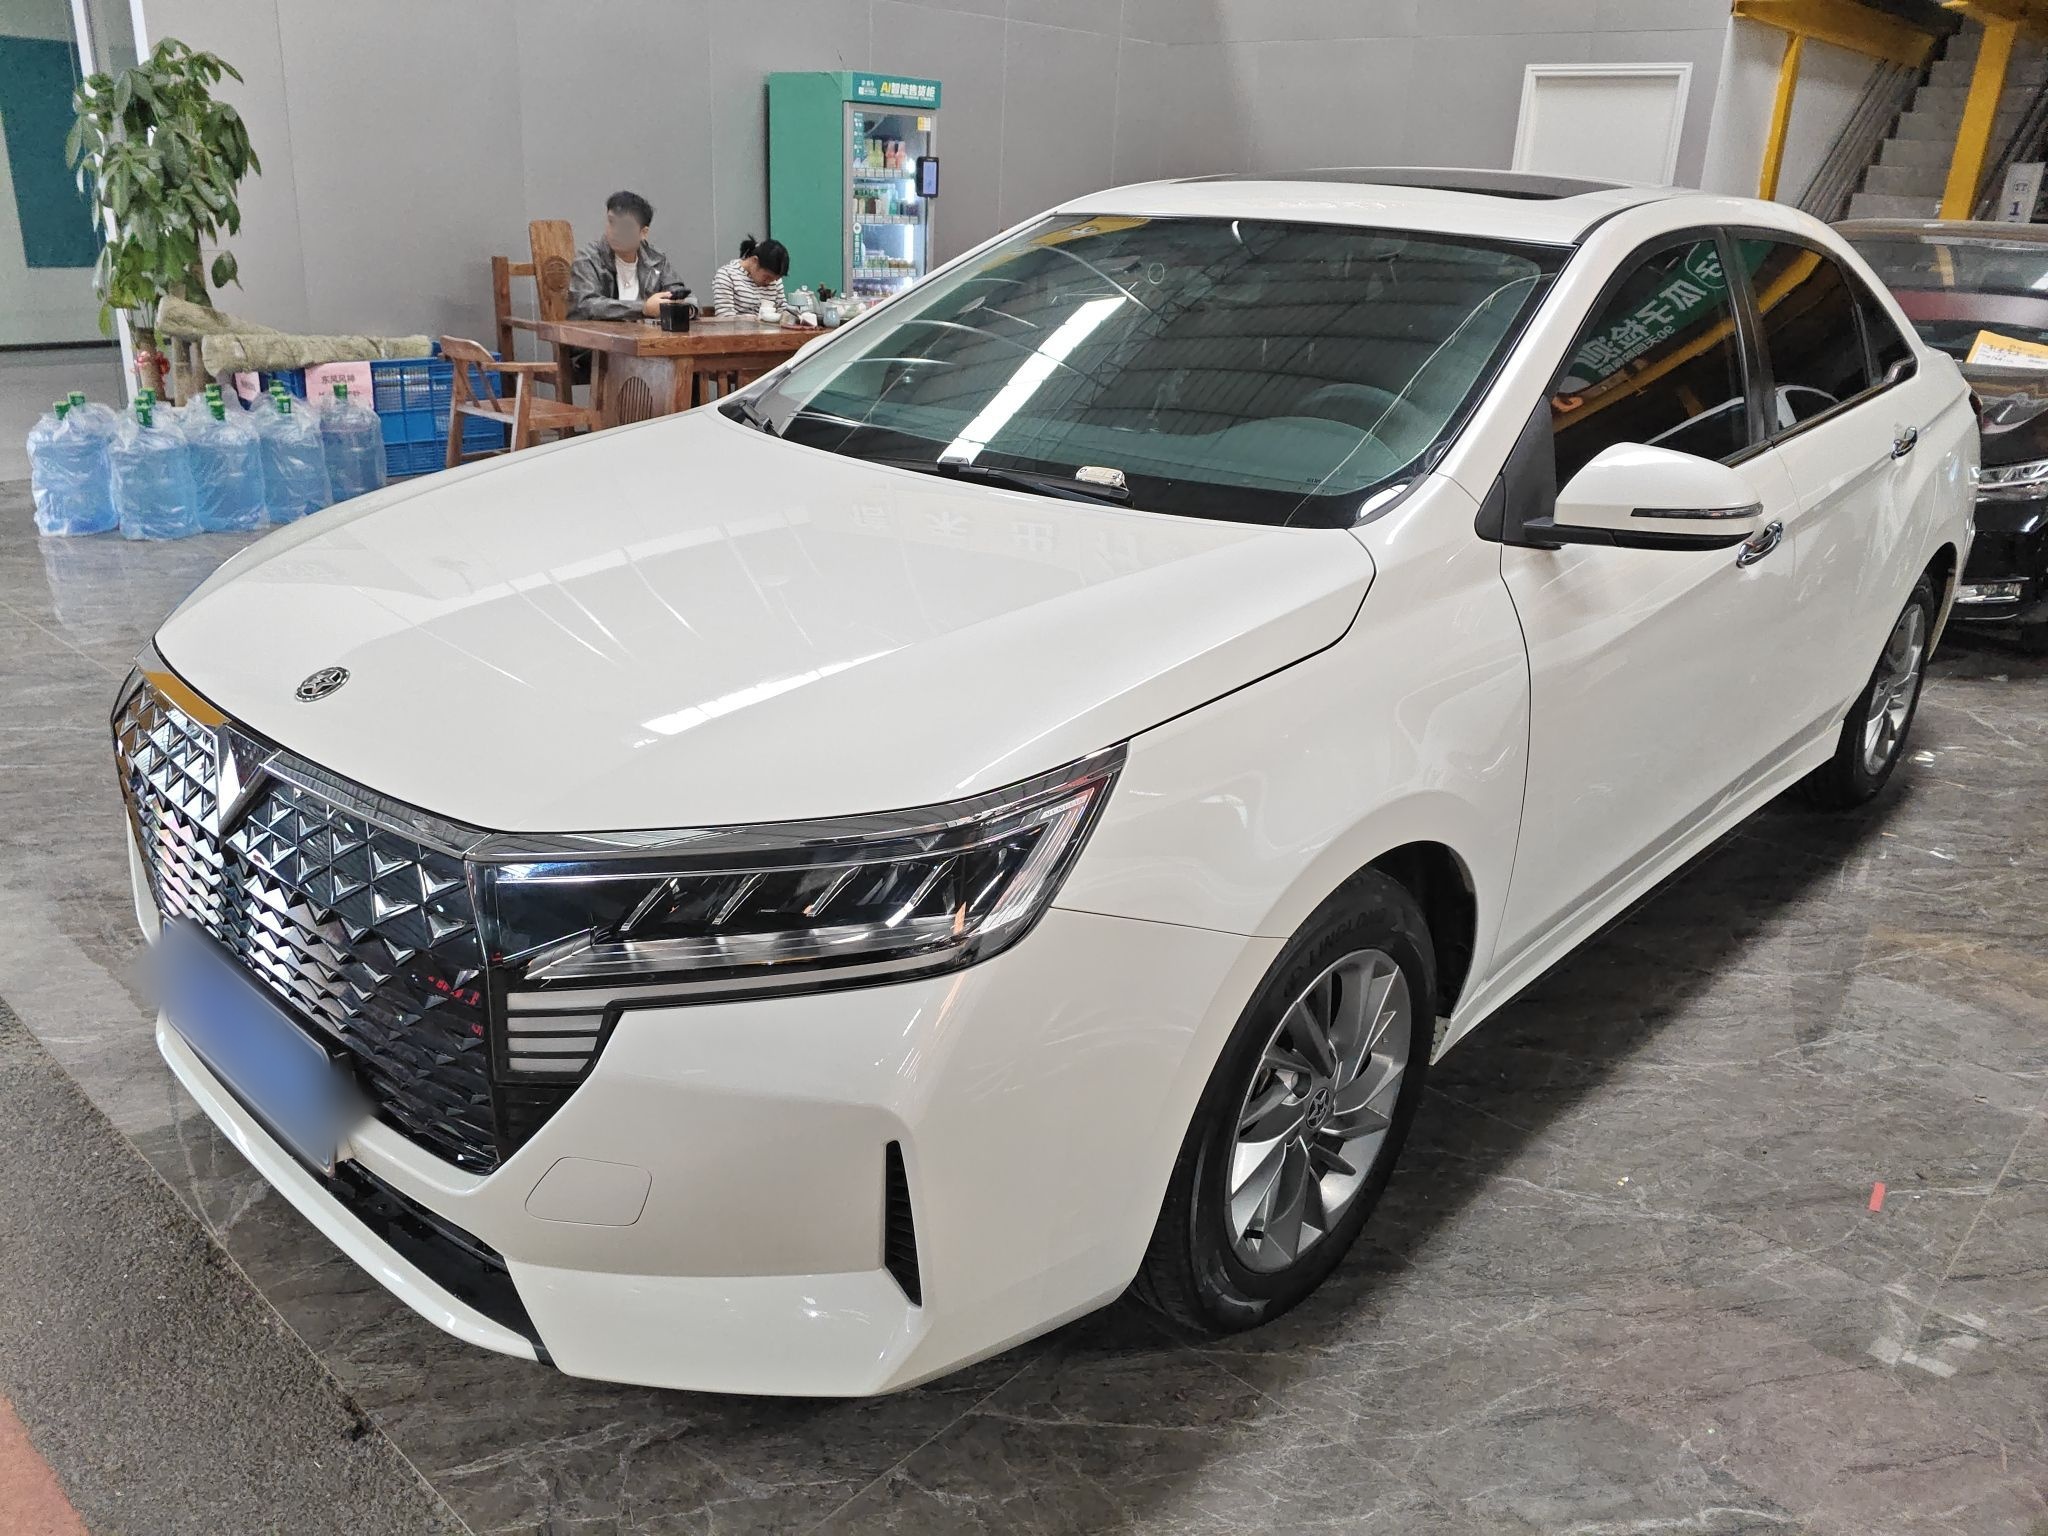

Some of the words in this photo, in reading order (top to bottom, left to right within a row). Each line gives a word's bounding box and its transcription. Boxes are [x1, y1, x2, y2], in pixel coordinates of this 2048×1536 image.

[880, 81, 936, 98] AI智能售货柜
